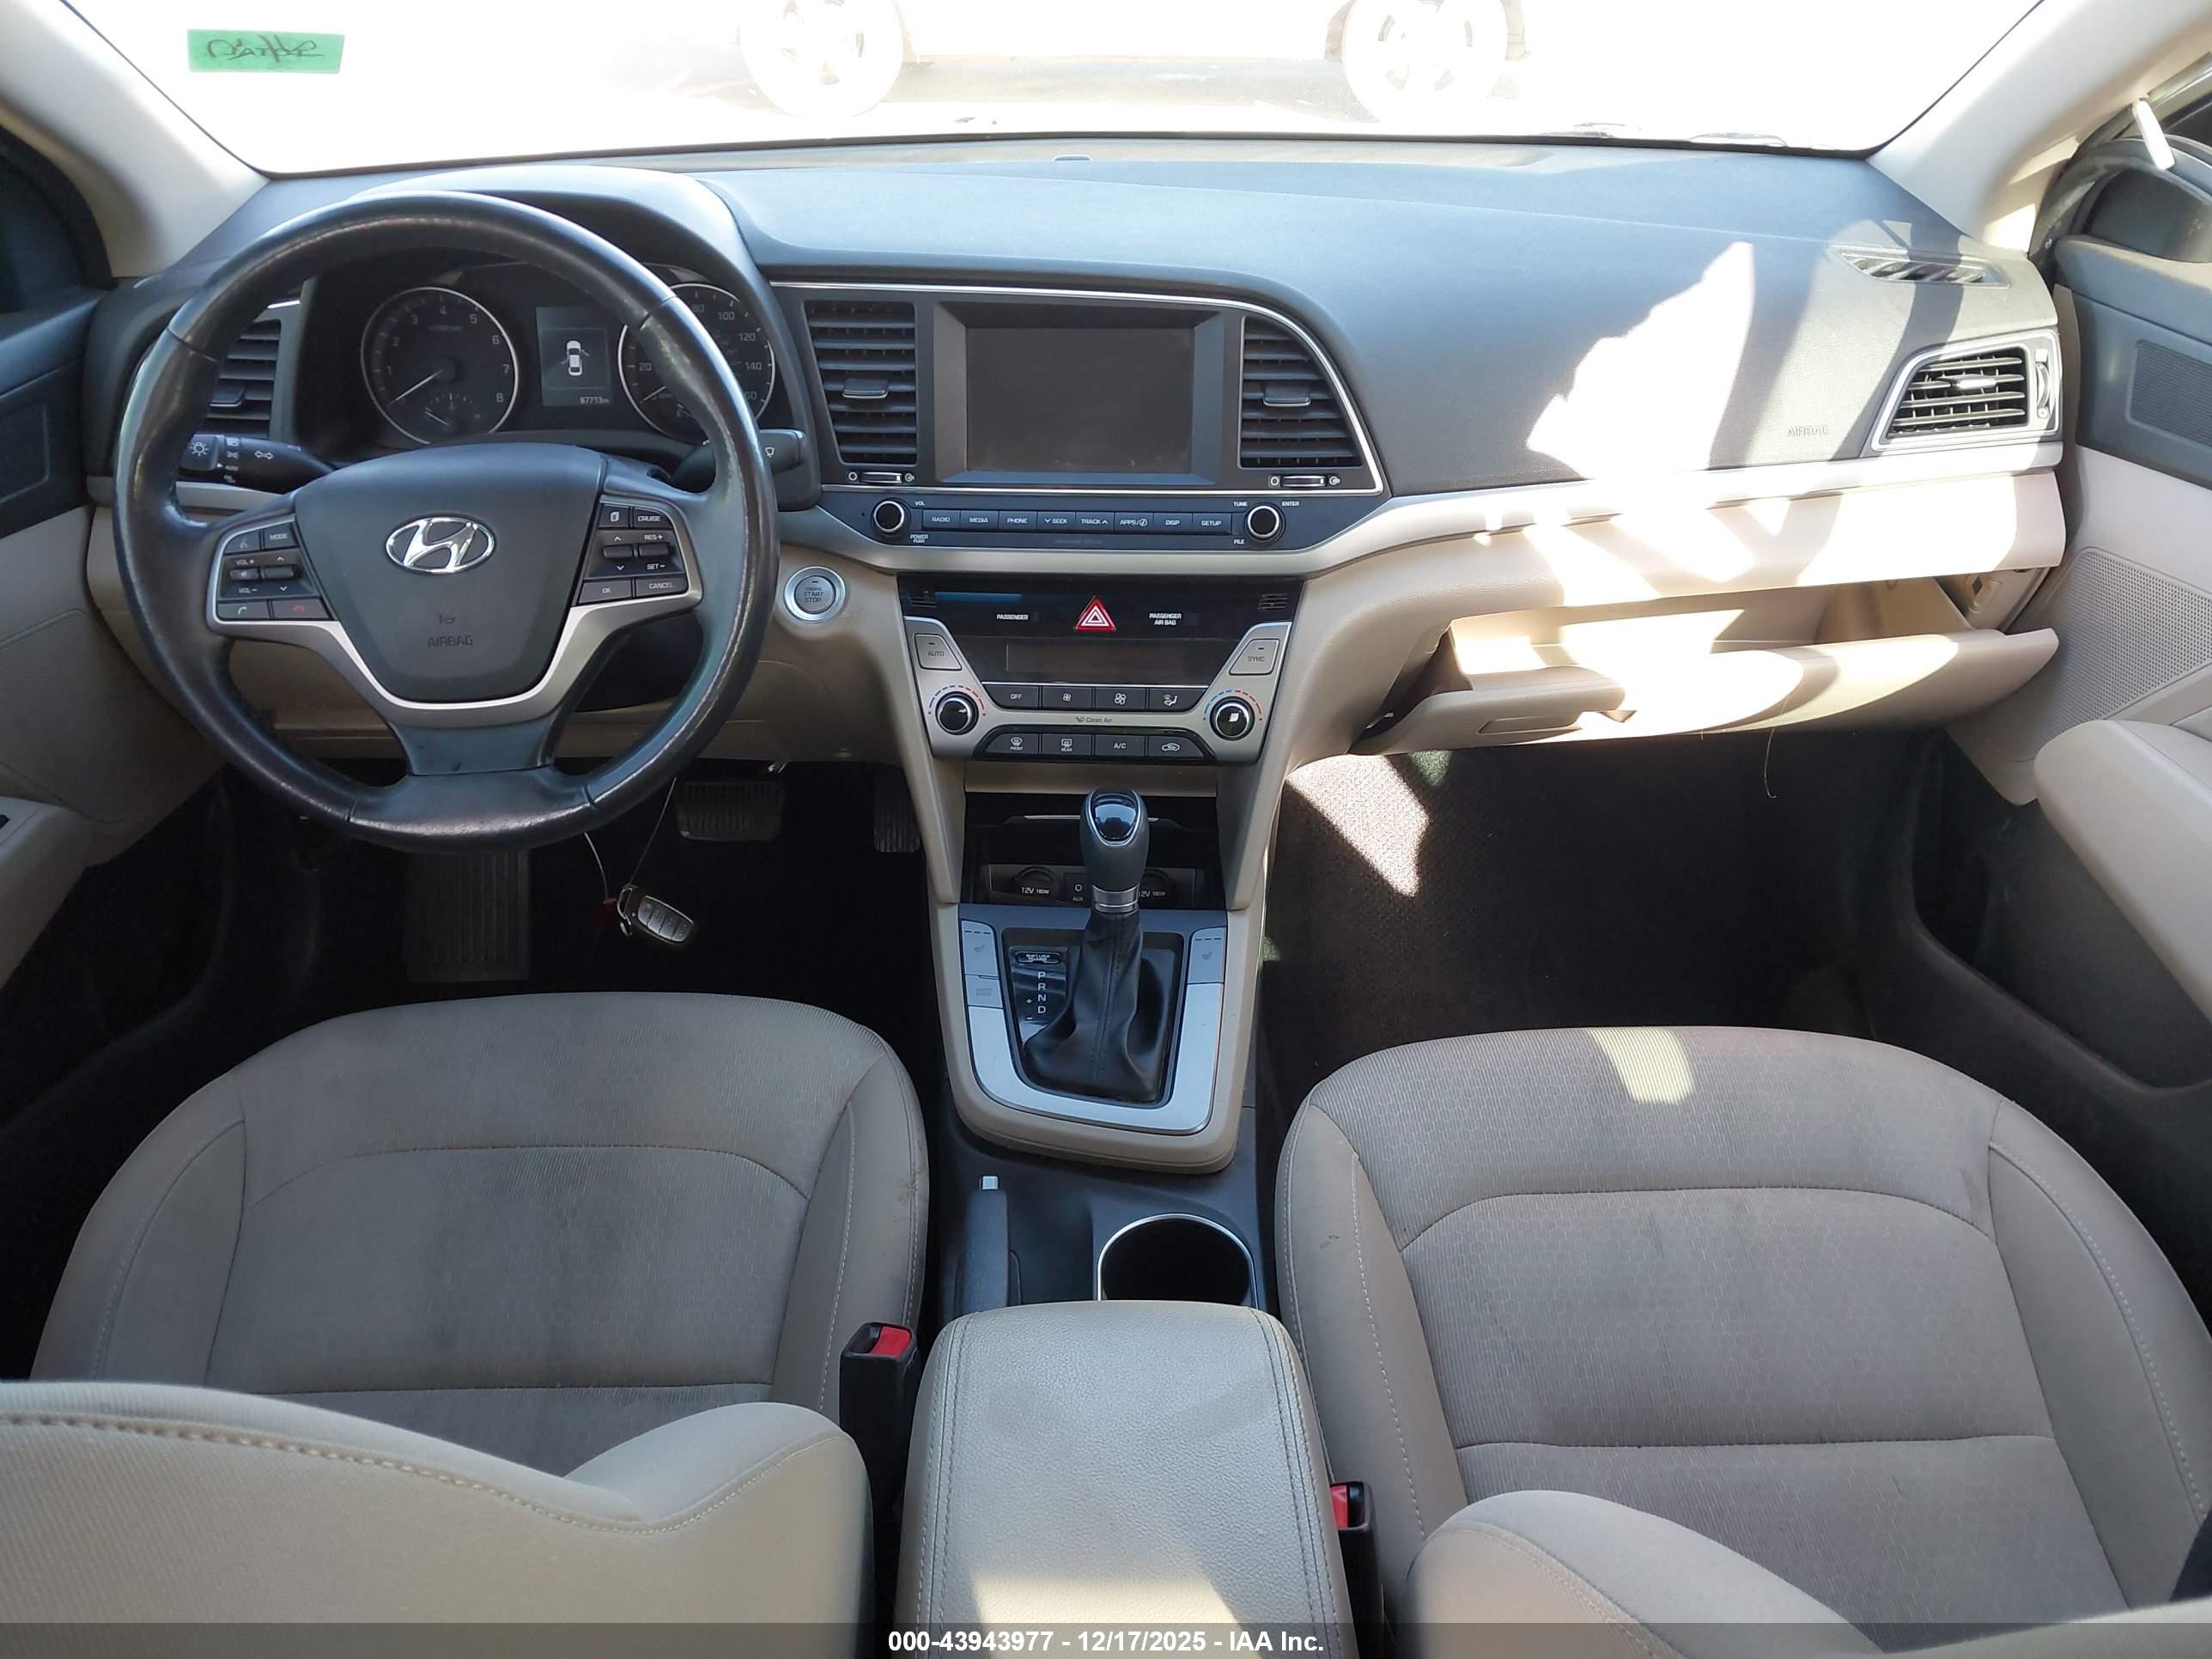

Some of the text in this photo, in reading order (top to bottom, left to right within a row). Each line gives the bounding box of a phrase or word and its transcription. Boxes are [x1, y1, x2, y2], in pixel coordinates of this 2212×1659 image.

[470, 314, 477, 324] 5
[718, 312, 735, 320] 100
[492, 335, 500, 344] 6
[738, 333, 756, 342] 120
[502, 364, 509, 374] 7
[639, 362, 652, 372] 20
[744, 362, 762, 370] 140
[496, 393, 504, 403] 8
[1787, 425, 1828, 437] AIRBAG
[428, 636, 473, 647] AIRBAG
[1037, 1006, 1047, 1014] D
